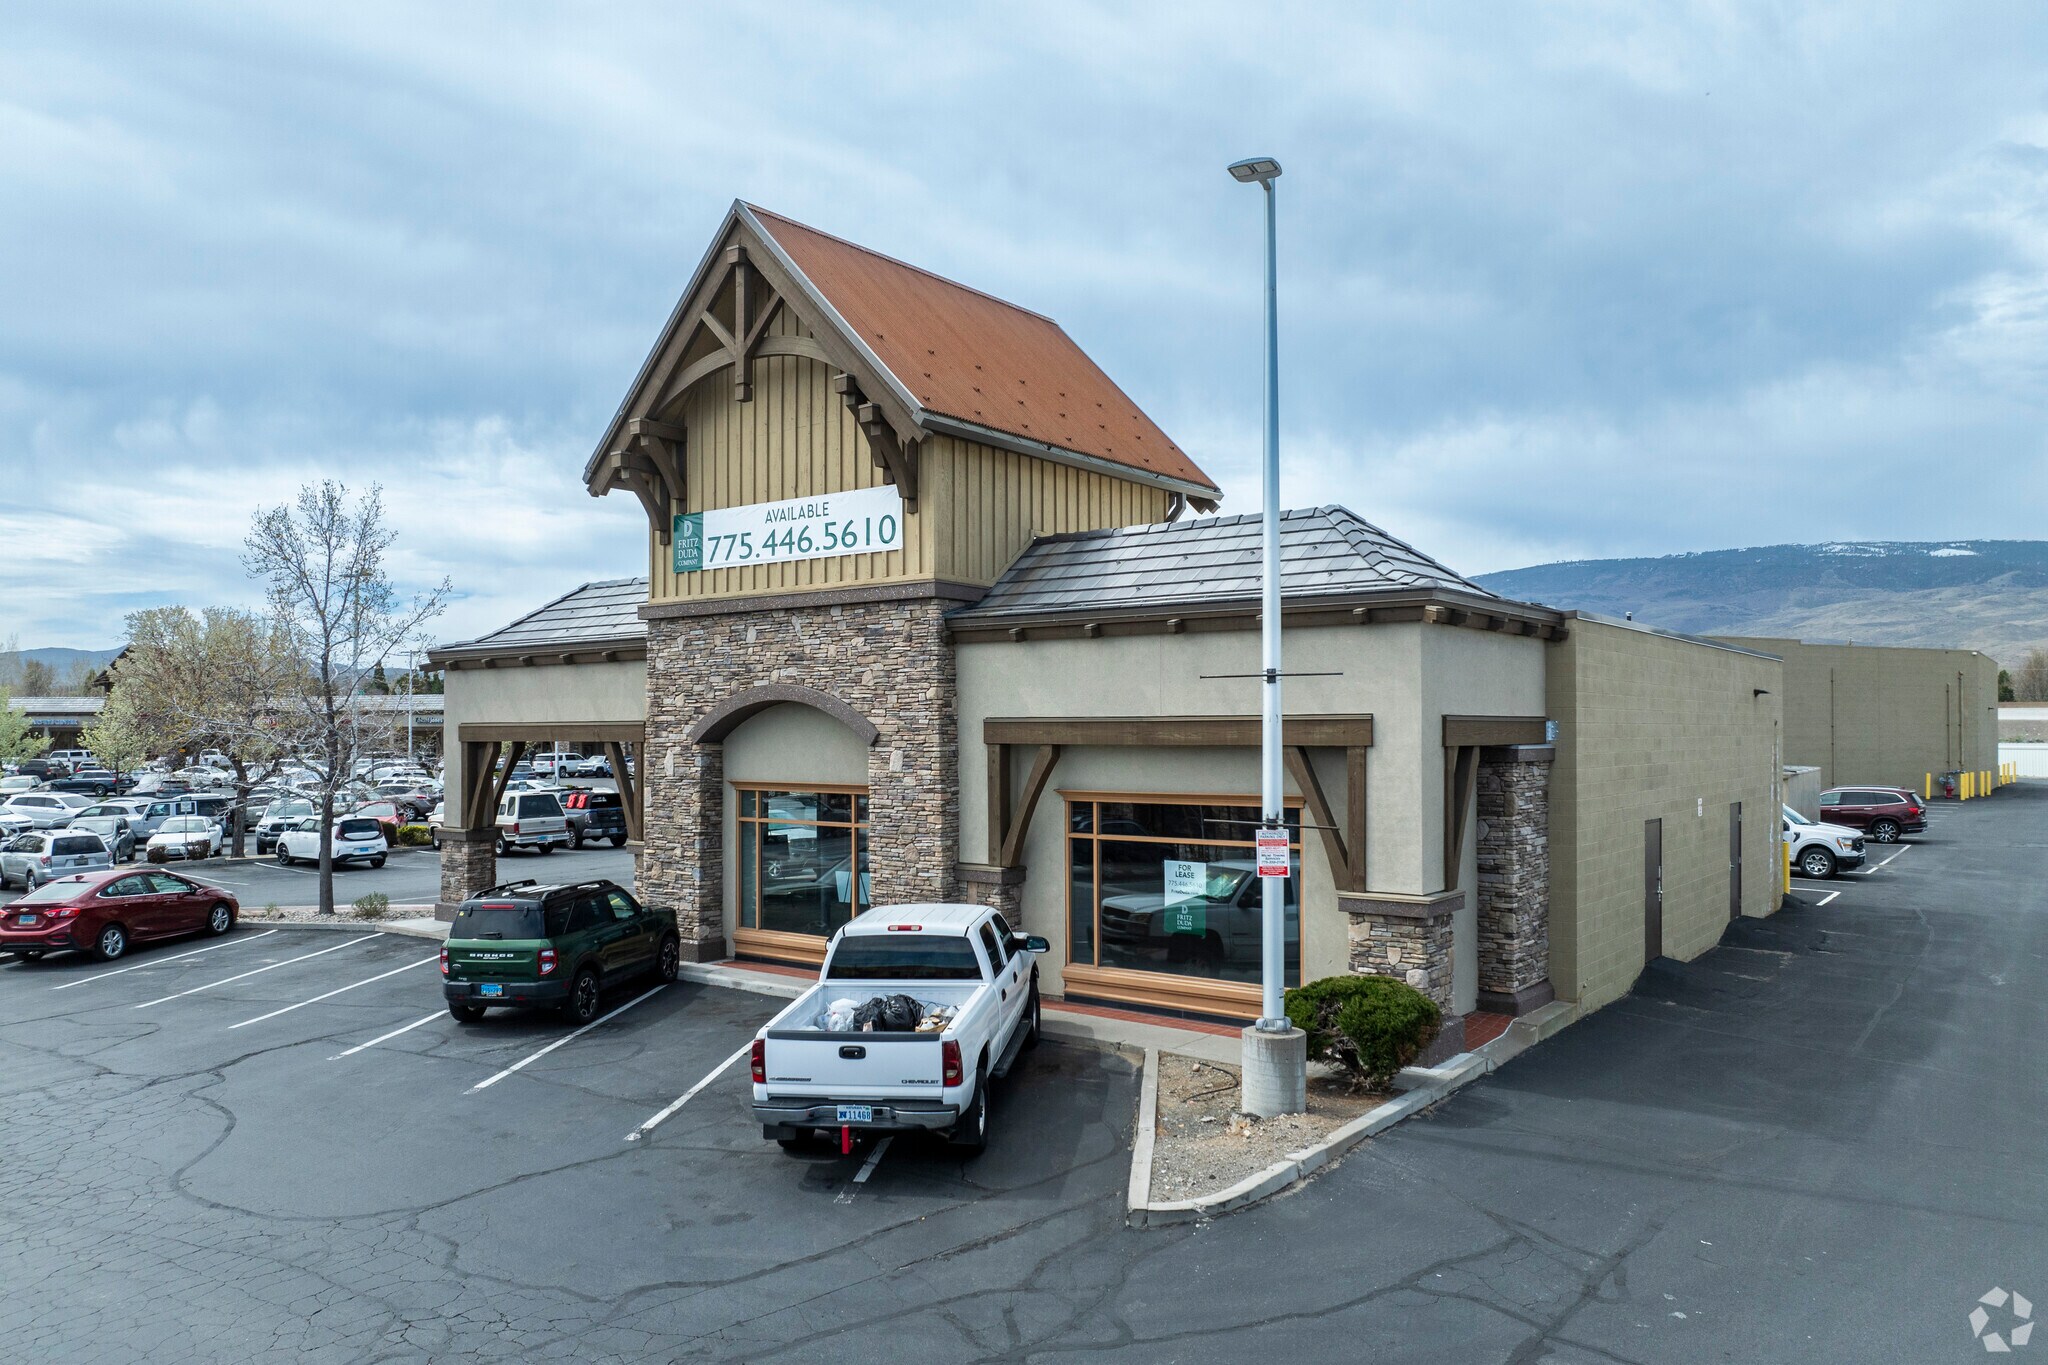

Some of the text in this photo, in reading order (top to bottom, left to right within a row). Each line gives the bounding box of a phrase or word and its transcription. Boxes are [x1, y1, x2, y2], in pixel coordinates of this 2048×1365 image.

[765, 502, 829, 524] AVAILABLE
[683, 520, 693, 537] D
[678, 538, 699, 548] FRITZ
[708, 514, 896, 563] 775.446.5610
[678, 549, 698, 559] DUDA
[677, 559, 698, 567] COMPANY
[1178, 864, 1192, 872] FOR
[1175, 871, 1195, 879] LEASE
